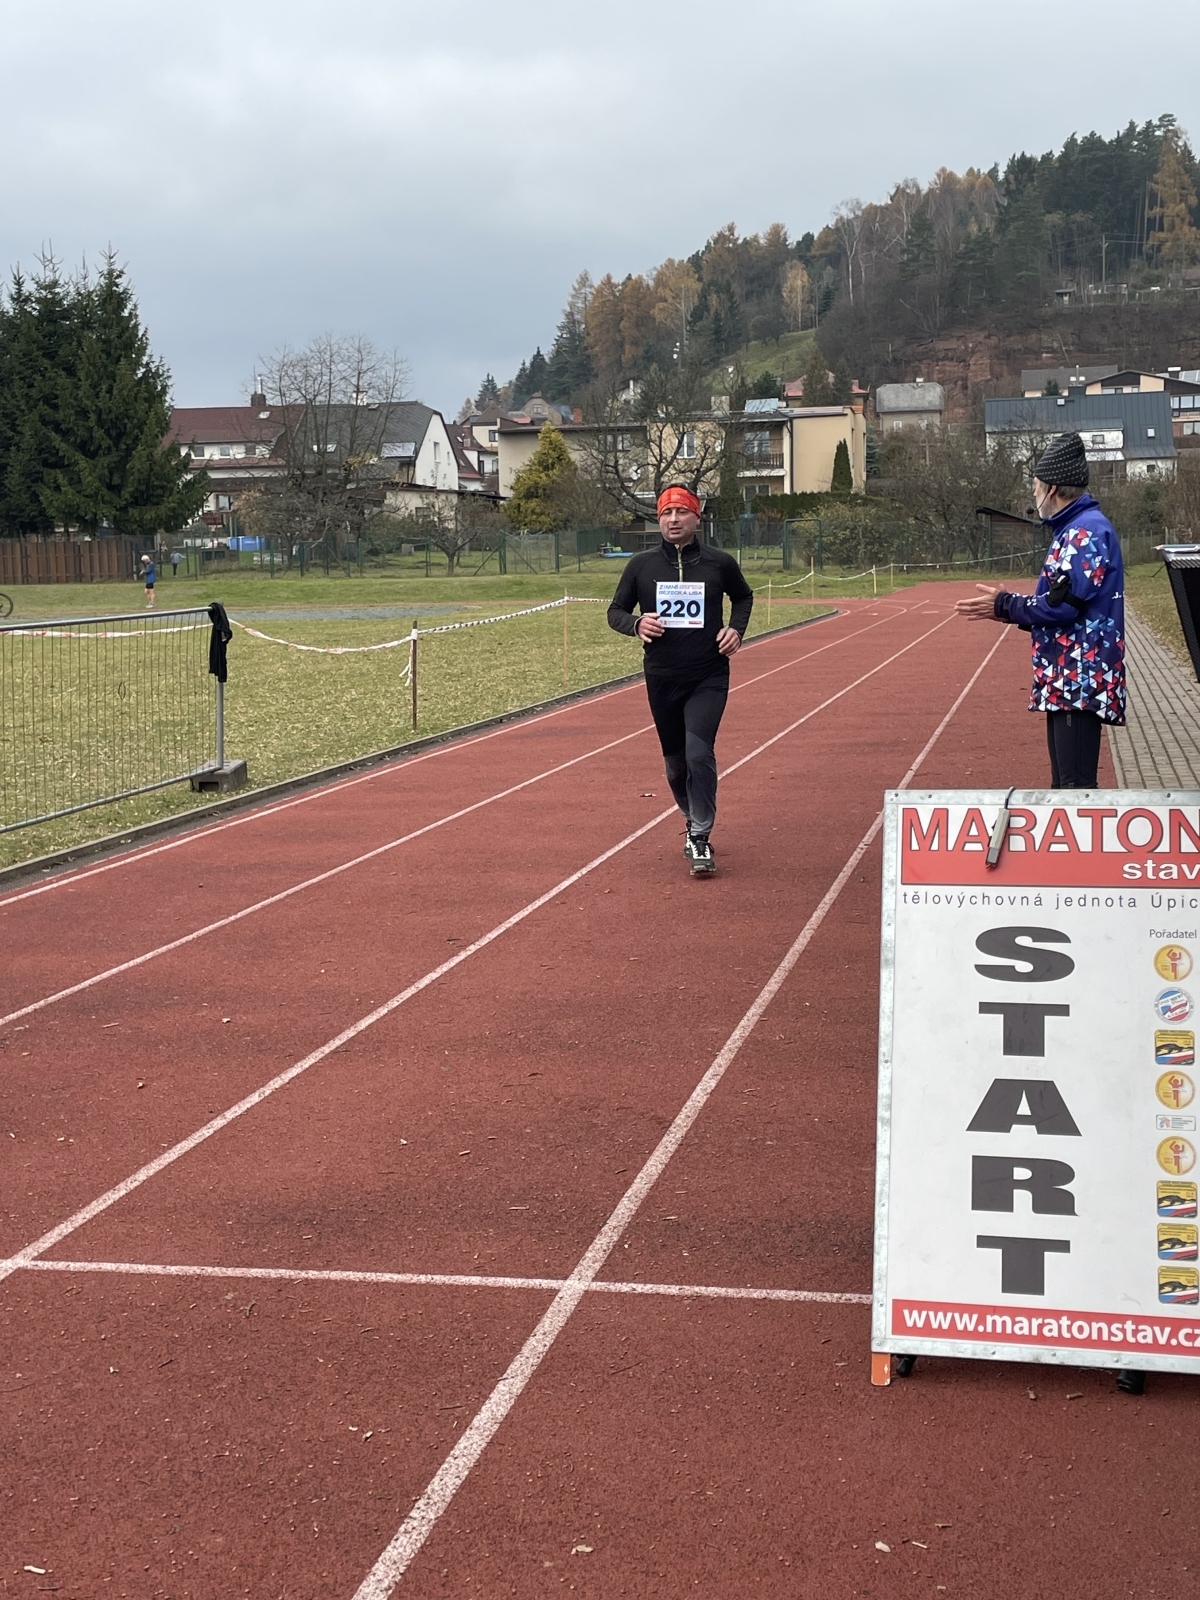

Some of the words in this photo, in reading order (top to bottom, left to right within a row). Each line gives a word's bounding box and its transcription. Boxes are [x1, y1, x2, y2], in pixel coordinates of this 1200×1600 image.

[660, 600, 701, 618] 220
[902, 807, 1200, 854] MARATON
[1122, 859, 1200, 880] stav
[903, 891, 1044, 908] tělovýchovná
[1055, 893, 1138, 910] jednota
[1151, 892, 1199, 912] Úpic
[1149, 928, 1198, 939] Pořadatel
[965, 926, 1083, 1297] START
